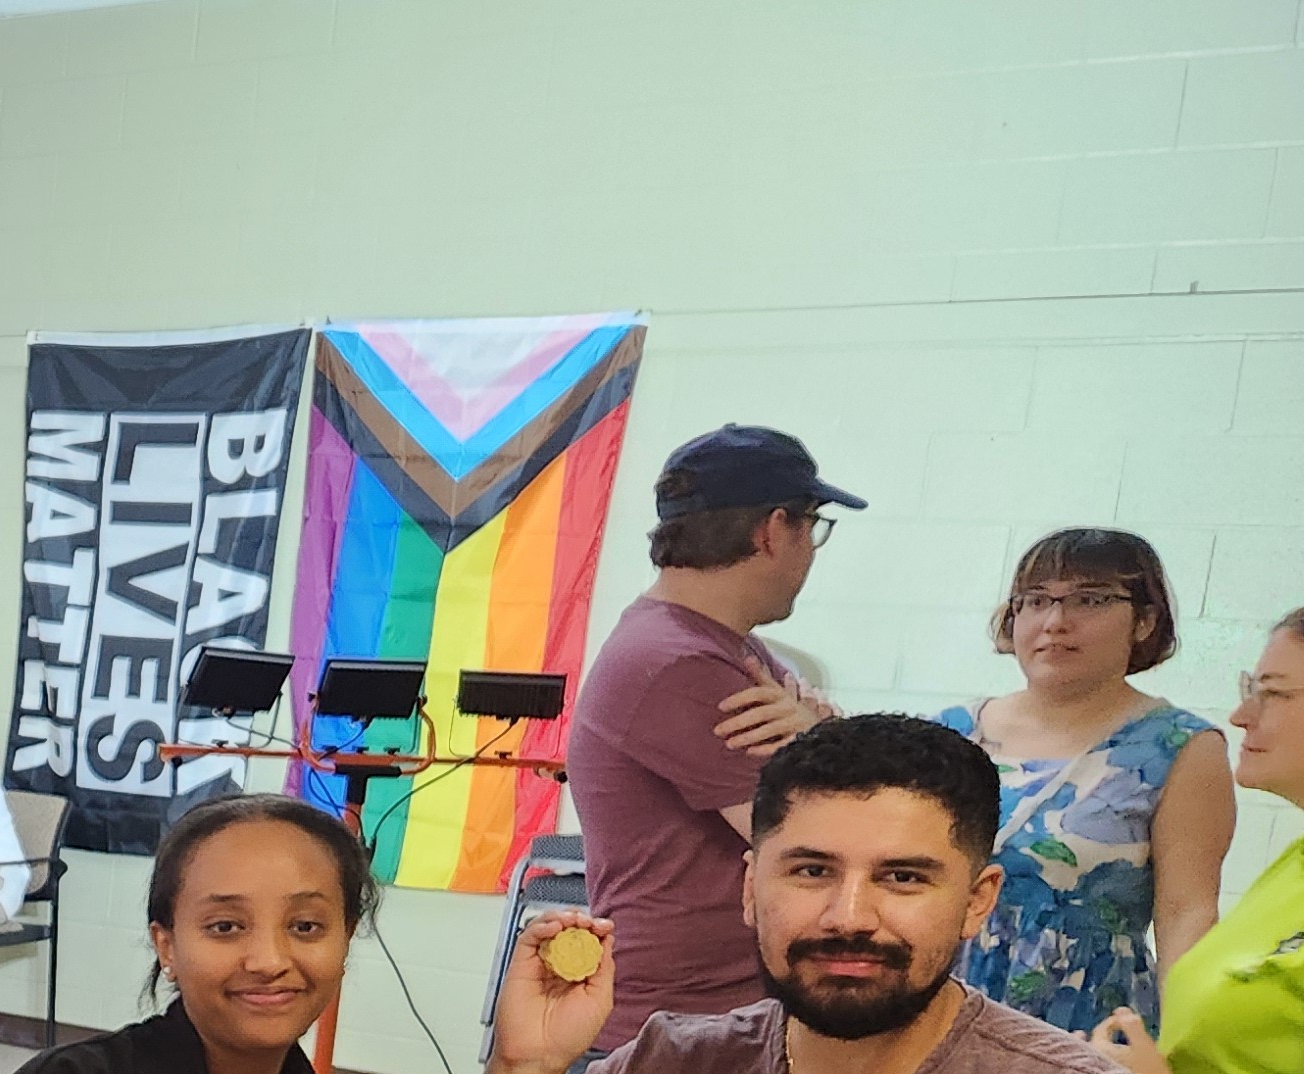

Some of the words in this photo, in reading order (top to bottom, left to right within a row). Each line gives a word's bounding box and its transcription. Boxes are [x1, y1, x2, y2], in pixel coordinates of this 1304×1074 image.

[12, 411, 107, 779] MATTER
[85, 420, 199, 784] LIVES
[175, 407, 289, 796] BLAK
